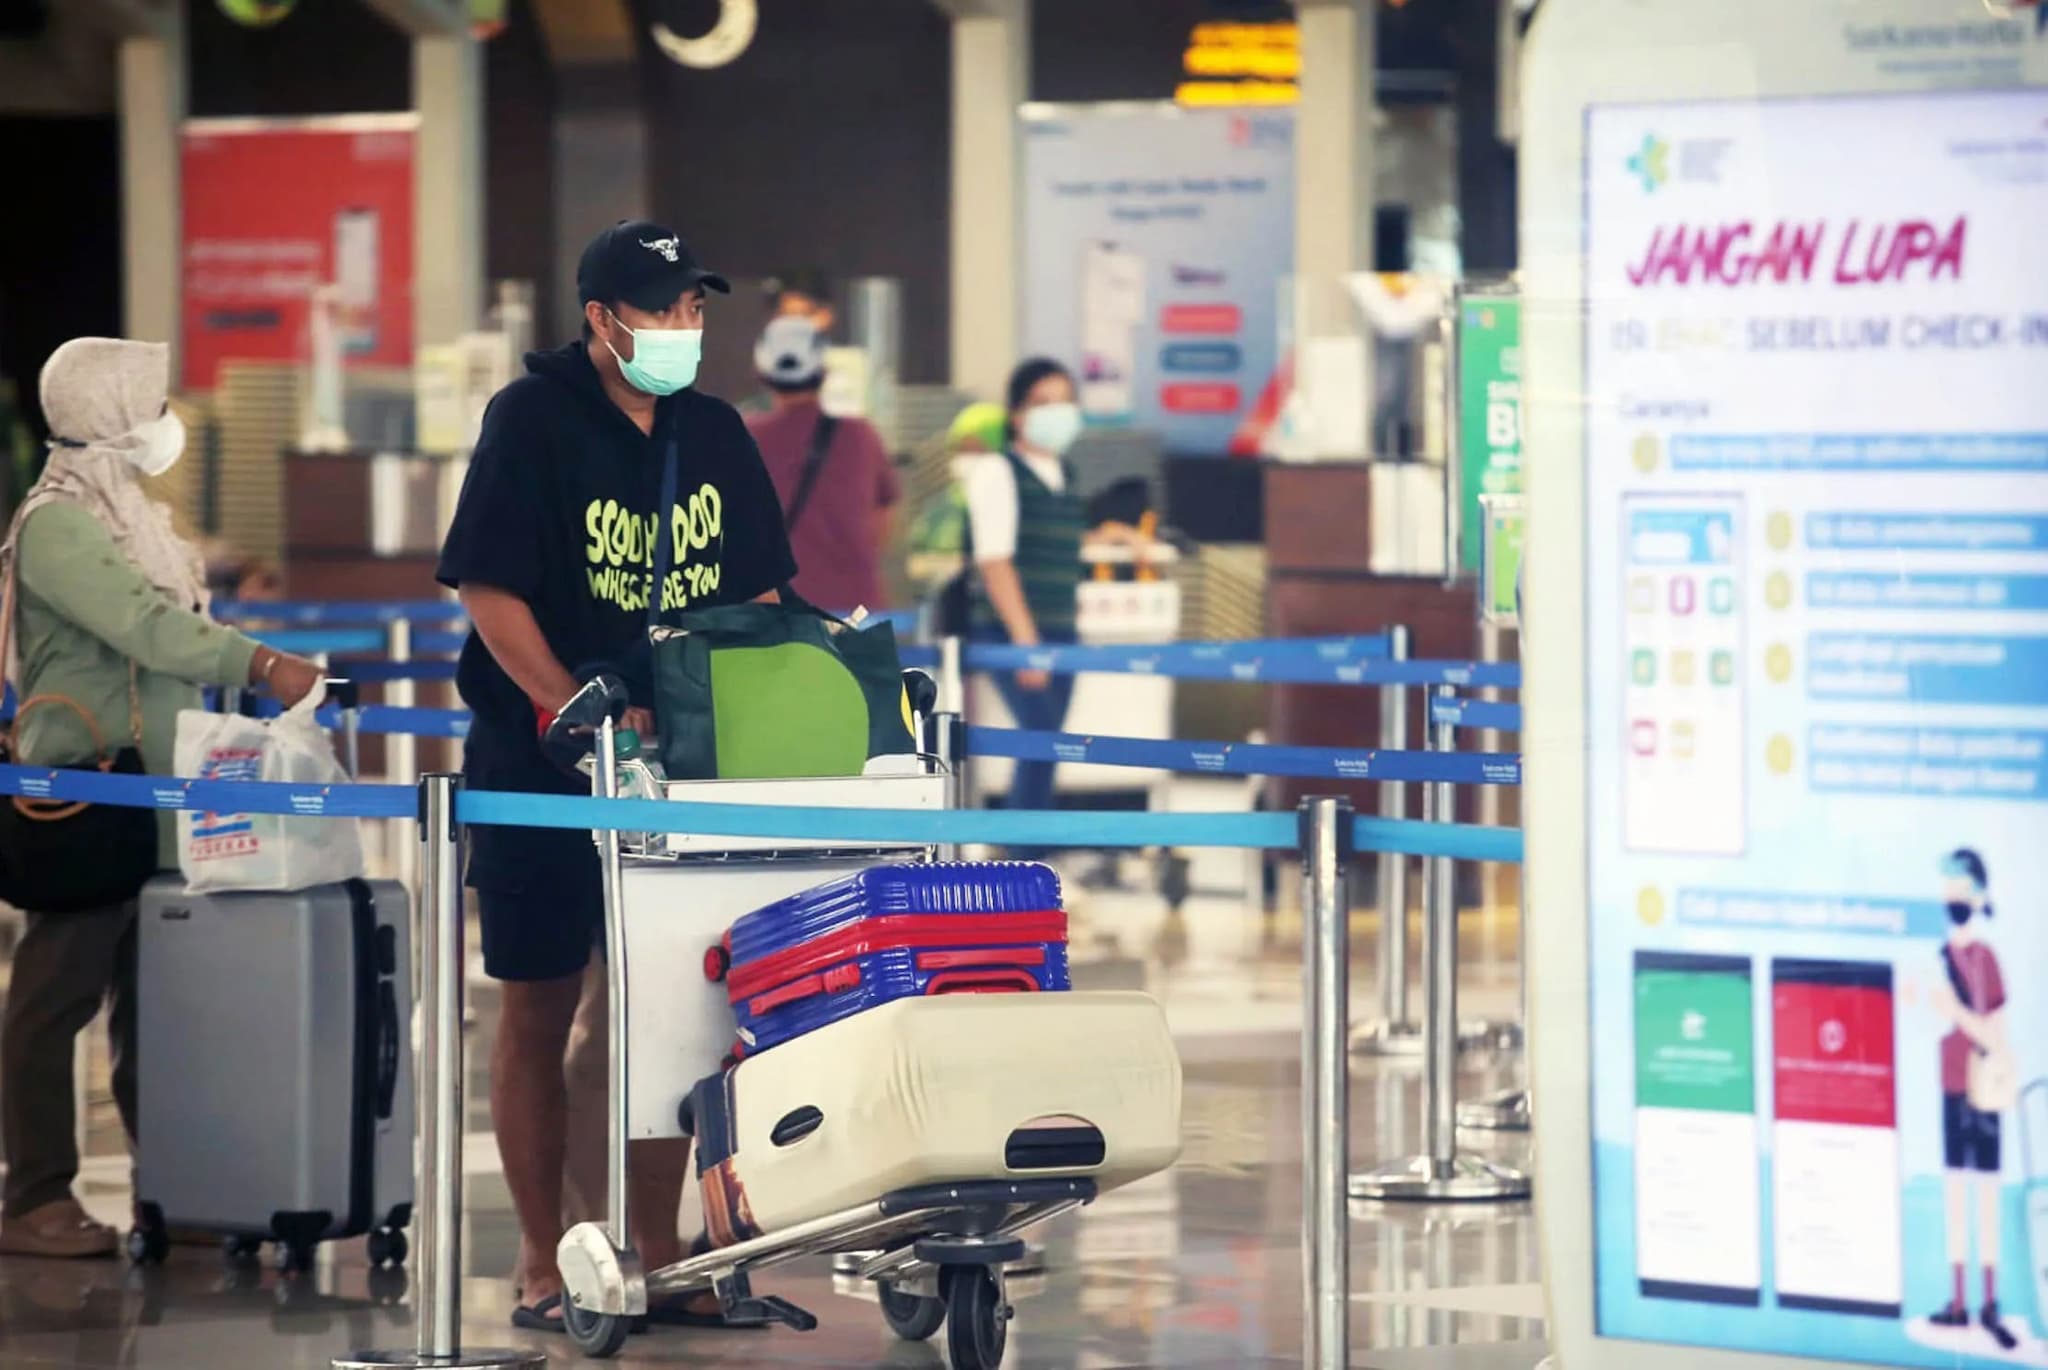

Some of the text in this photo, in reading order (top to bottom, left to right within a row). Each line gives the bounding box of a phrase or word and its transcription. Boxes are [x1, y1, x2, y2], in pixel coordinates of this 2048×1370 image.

[1625, 213, 1967, 287] JANGAN LUPA
[1746, 314, 1891, 350] SEBELUM
[671, 483, 721, 565] DOO
[660, 571, 687, 612] RE
[684, 563, 720, 598] YOU
